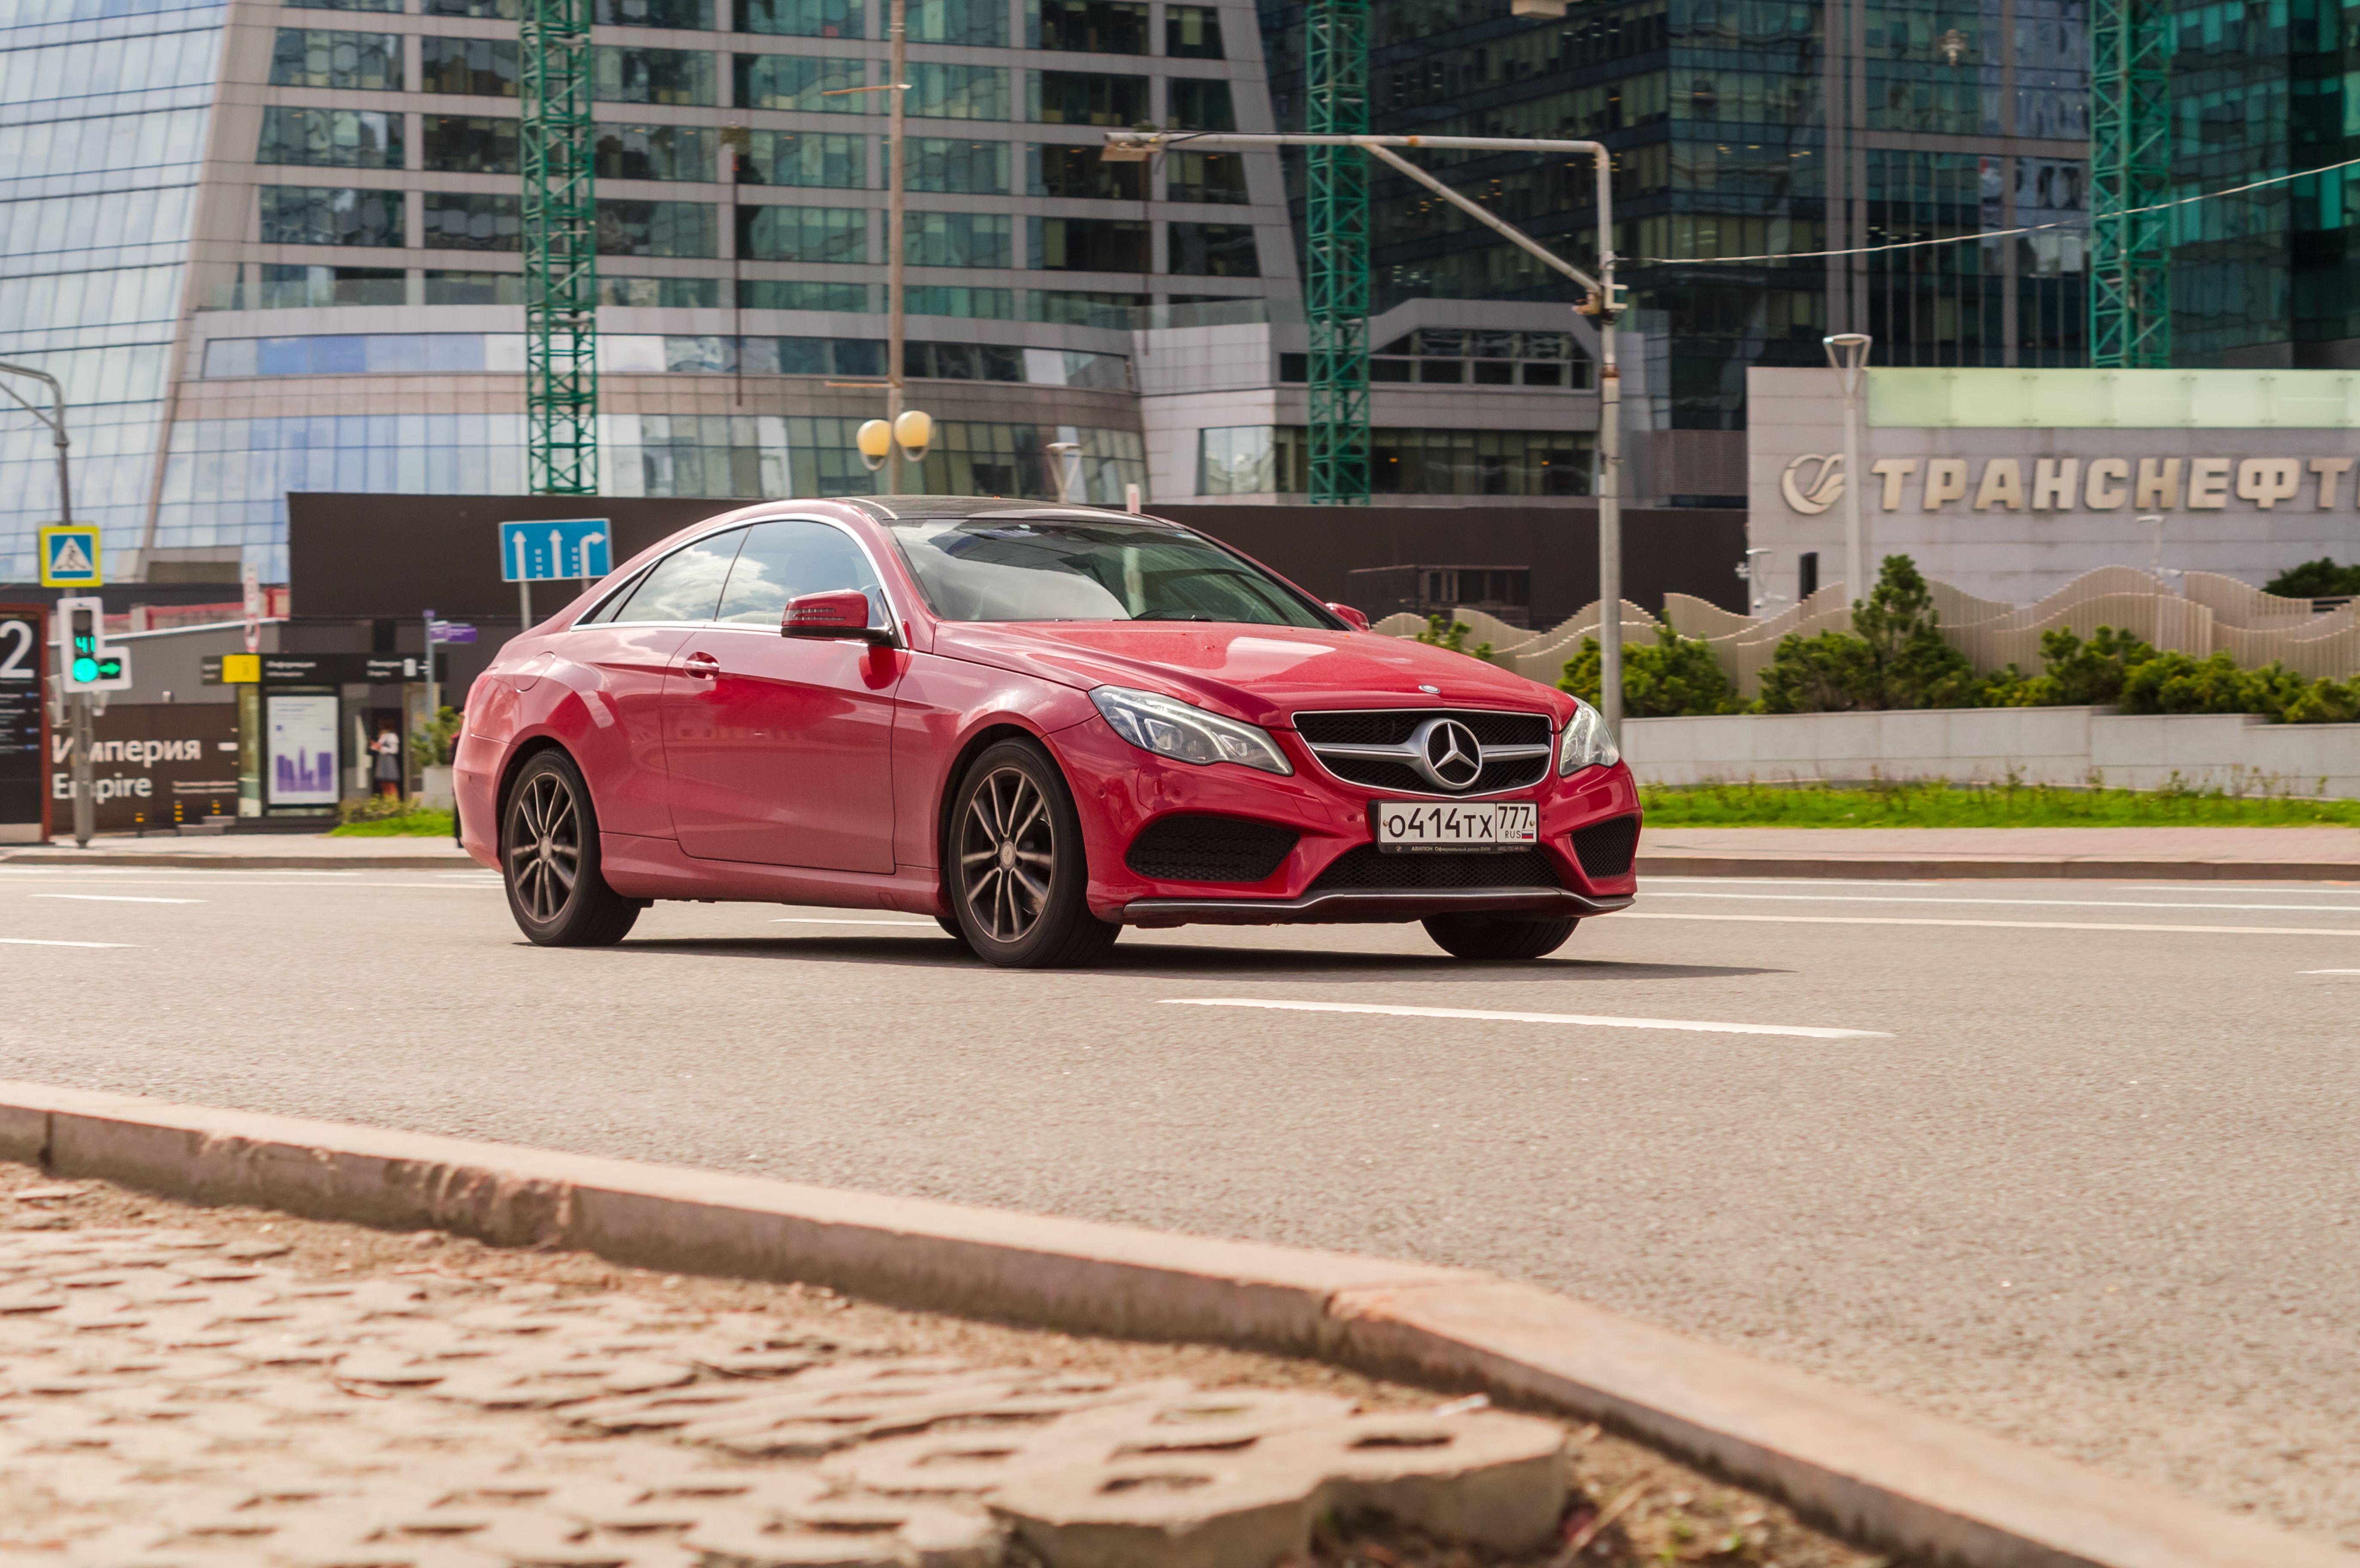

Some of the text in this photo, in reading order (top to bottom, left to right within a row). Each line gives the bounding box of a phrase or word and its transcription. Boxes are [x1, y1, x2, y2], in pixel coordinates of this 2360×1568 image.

[1871, 457, 2360, 511] ТРАНСНЕФТ
[0, 620, 34, 679] 2
[75, 636, 95, 653] 41
[1498, 806, 1530, 829] 777
[1505, 830, 1521, 839] RUS
